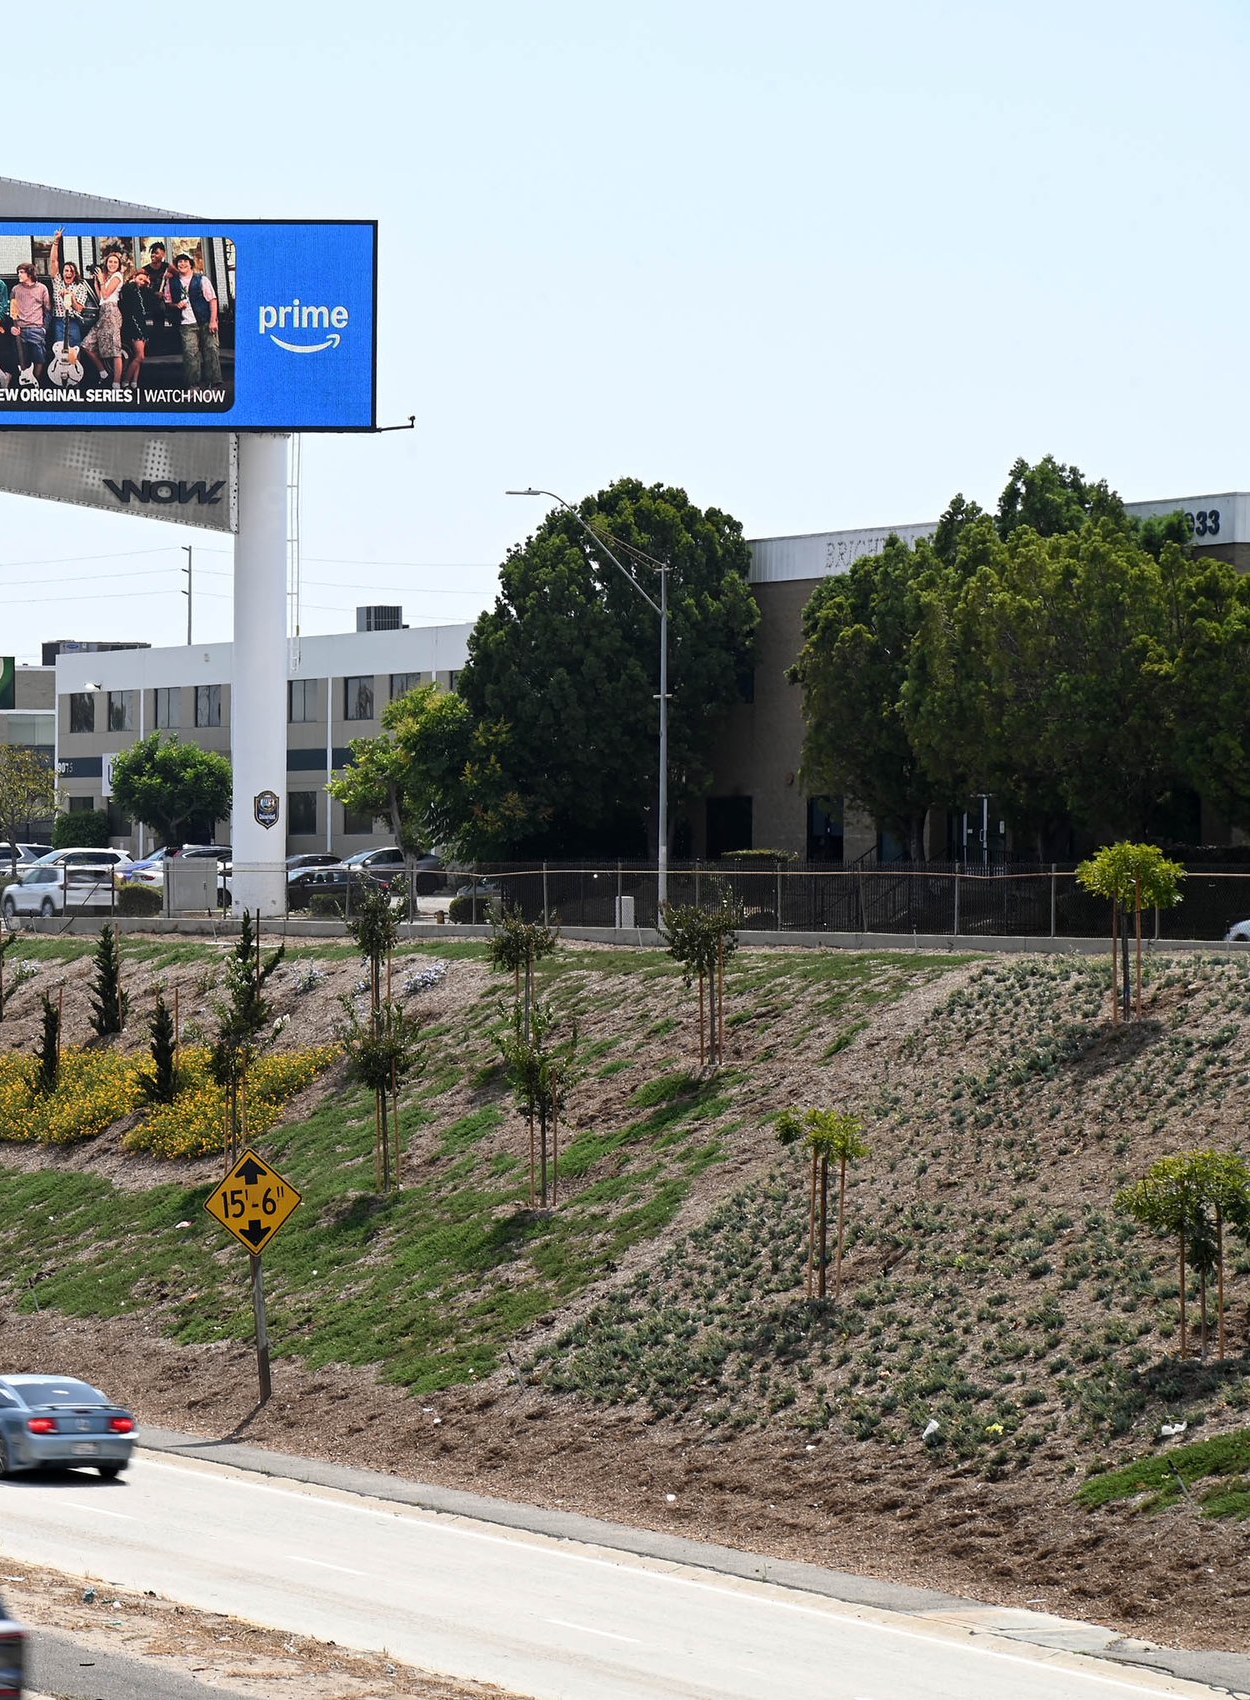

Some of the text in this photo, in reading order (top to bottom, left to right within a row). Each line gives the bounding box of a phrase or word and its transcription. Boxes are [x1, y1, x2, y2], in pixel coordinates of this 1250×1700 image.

[259, 299, 349, 334] prime
[20, 388, 85, 403] ORIGINAL
[85, 389, 133, 403] SERIES
[144, 389, 191, 403] WATCH
[192, 389, 226, 404] NOW
[221, 1186, 284, 1219] 15'-6"
